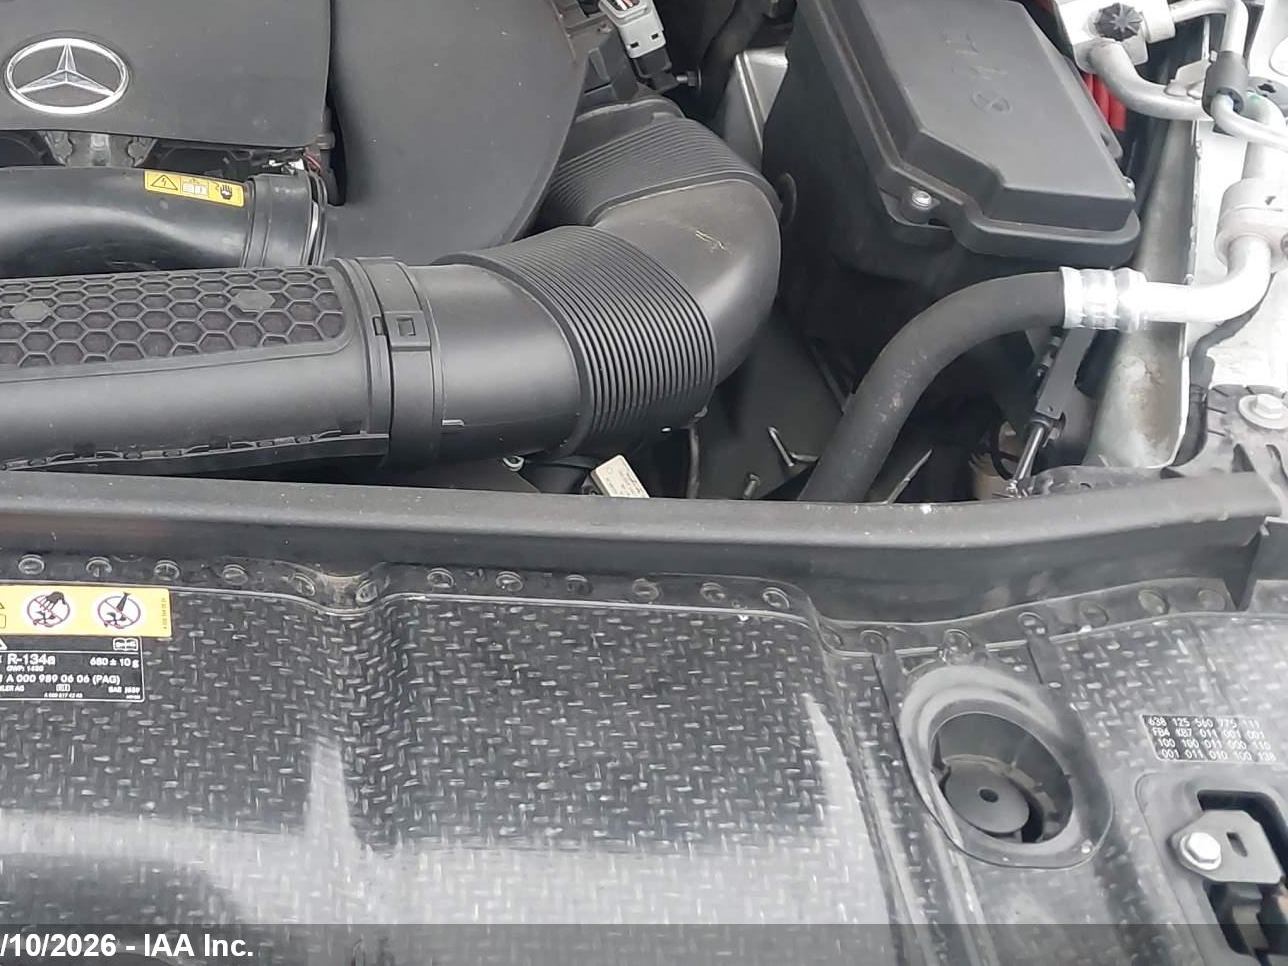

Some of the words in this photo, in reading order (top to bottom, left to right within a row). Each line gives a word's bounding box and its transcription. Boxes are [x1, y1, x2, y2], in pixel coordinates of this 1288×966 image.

[7, 653, 56, 666] R-134a
[89, 657, 109, 666] 680
[119, 658, 131, 667] 10
[131, 659, 140, 669] g
[6, 674, 15, 683] A
[16, 674, 37, 683] 000
[38, 674, 59, 683] 989
[60, 674, 75, 683] 06
[76, 674, 91, 684] 06
[92, 674, 121, 686] (PAG)
[1149, 716, 1168, 727] 638
[1172, 717, 1191, 727] 125
[1194, 718, 1214, 729] 560
[1218, 718, 1238, 729] 775
[1152, 726, 1171, 737] FB4
[1175, 727, 1193, 737] KB7
[1199, 728, 1219, 739] 011
[1222, 729, 1242, 739] 001
[1157, 737, 1176, 748] 100
[1181, 738, 1200, 748] 100
[1204, 739, 1223, 749] 011
[1161, 748, 1180, 759] 001
[1185, 749, 1204, 759] 011
[1208, 750, 1228, 760] 010
